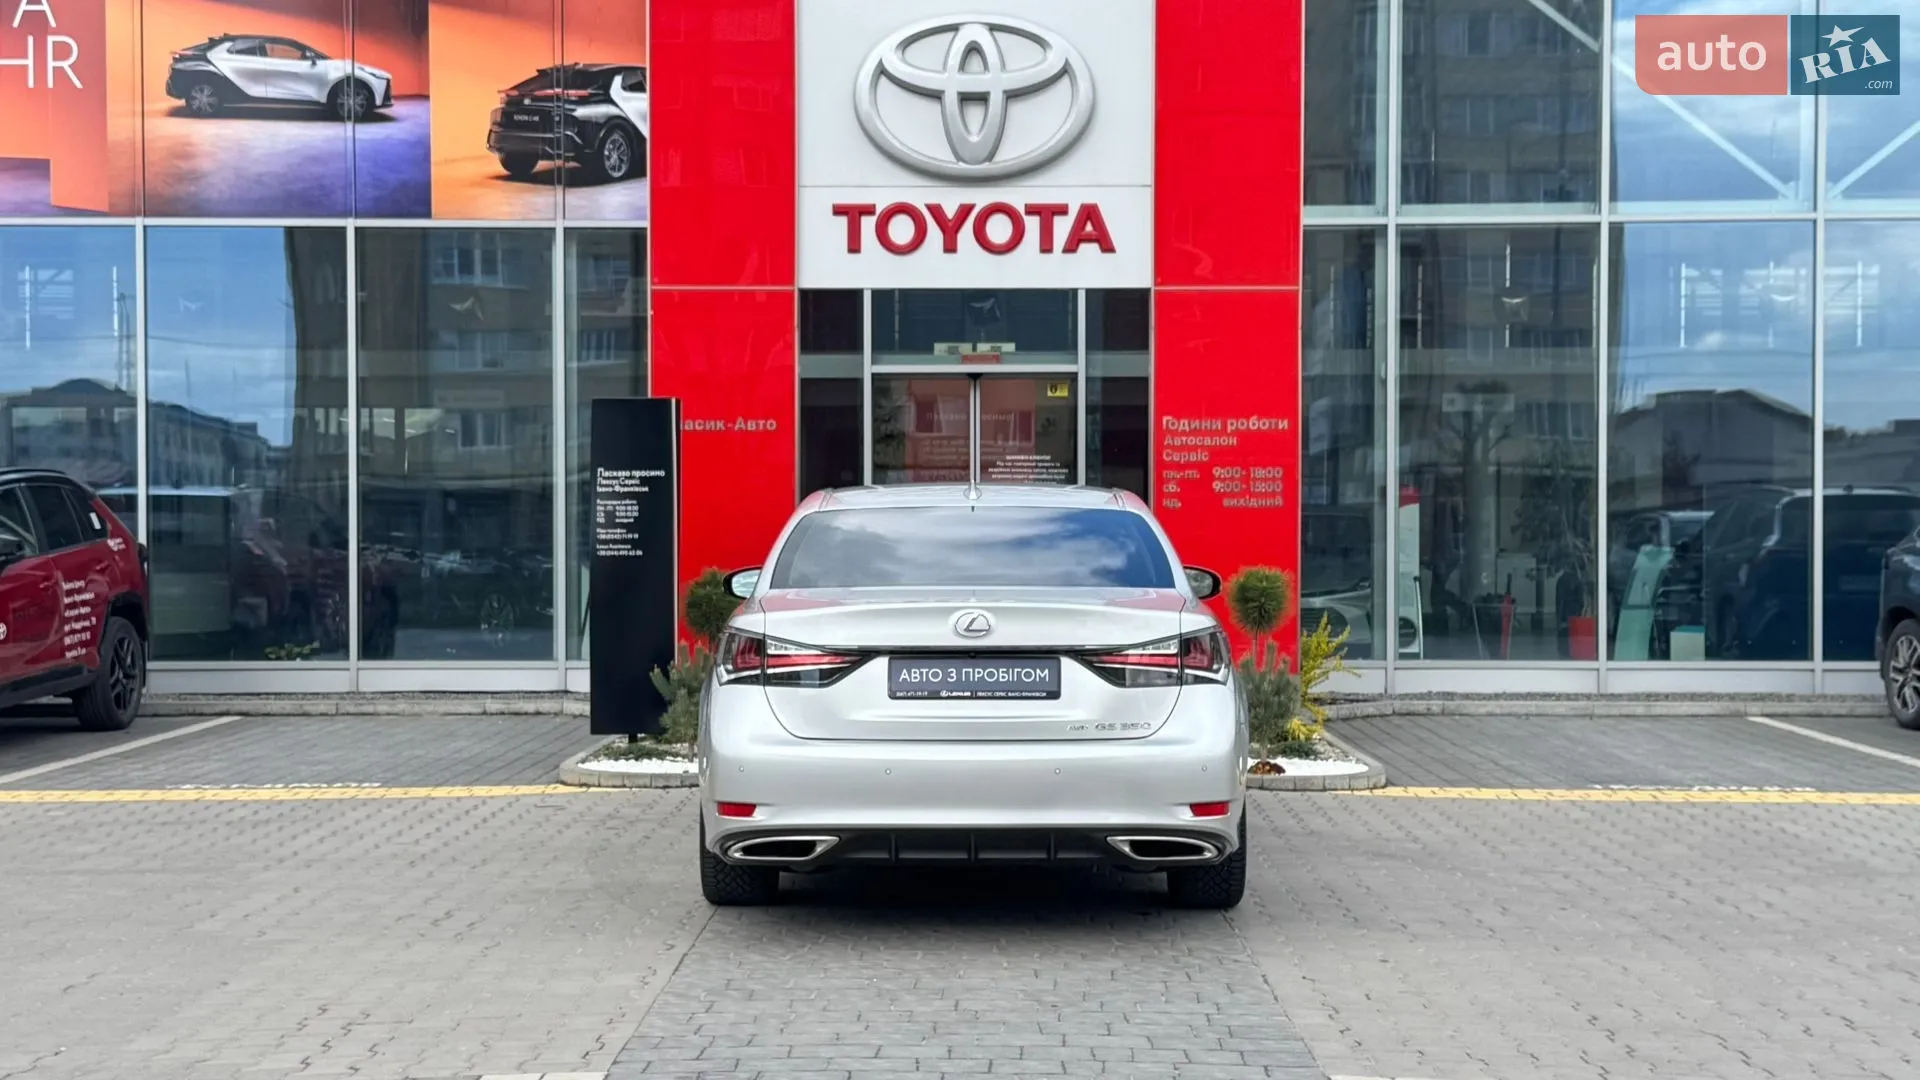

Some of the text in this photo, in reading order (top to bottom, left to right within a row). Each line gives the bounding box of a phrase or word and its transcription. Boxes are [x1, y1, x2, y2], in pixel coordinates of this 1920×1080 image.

[832, 201, 1117, 256] TOYOTA
[681, 416, 777, 431] асик-Авто
[1162, 415, 1288, 433] Години роботи
[1163, 435, 1237, 446] Автосалон
[1162, 449, 1209, 463] Сервіс
[631, 469, 666, 479] просимо
[1223, 496, 1283, 508] вихідний
[899, 668, 943, 682] АВТО
[962, 668, 1049, 682] ПРОБІГОМ
[1095, 722, 1118, 732] GS
[1119, 721, 1152, 731] 350
